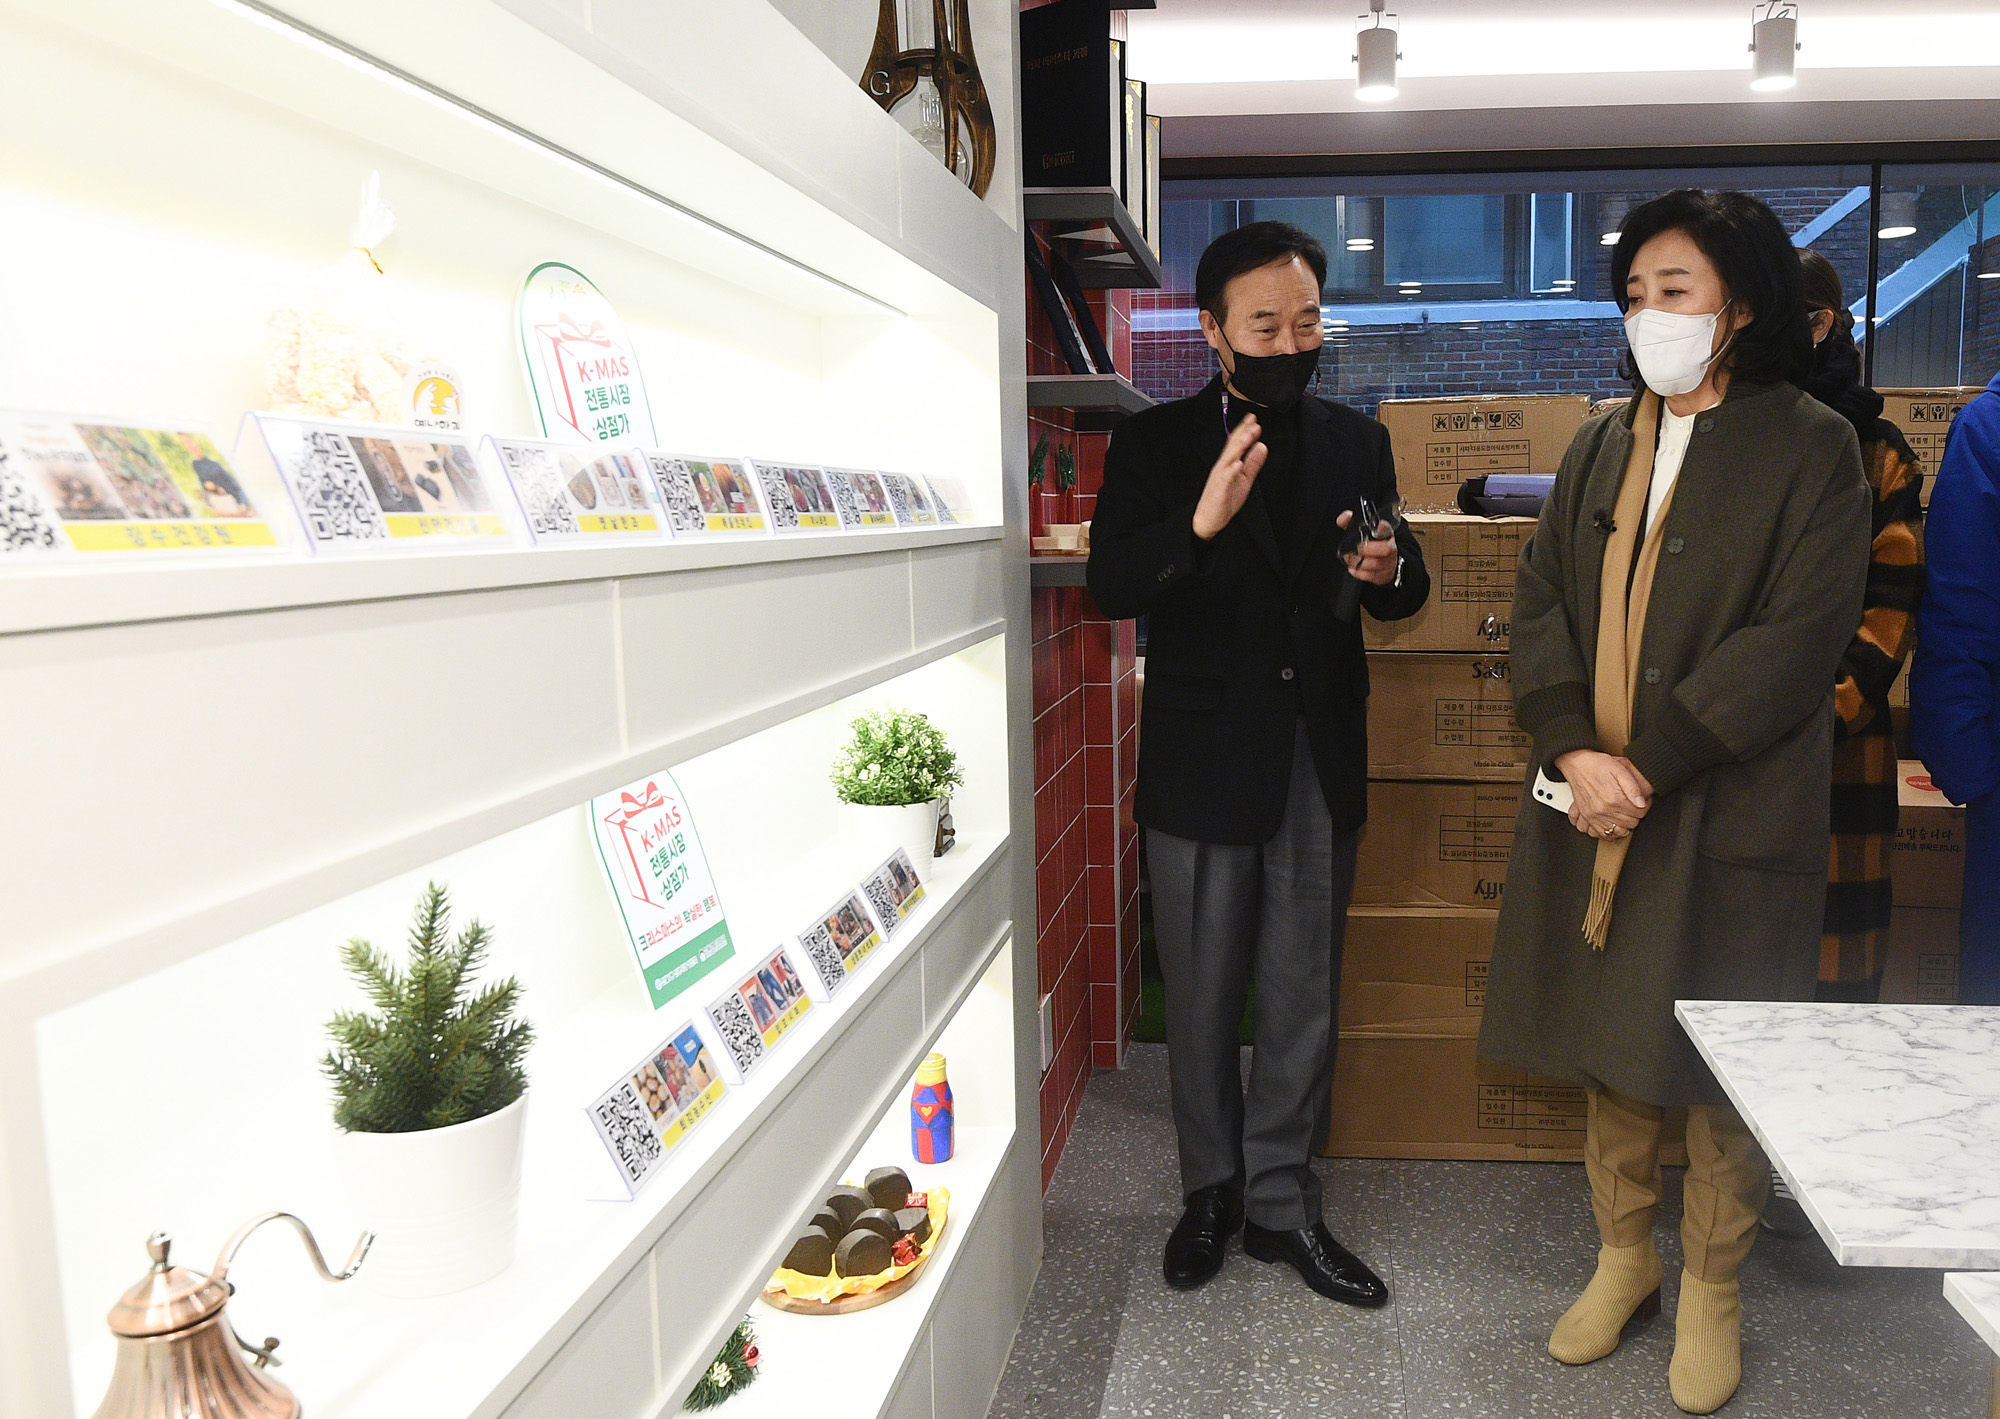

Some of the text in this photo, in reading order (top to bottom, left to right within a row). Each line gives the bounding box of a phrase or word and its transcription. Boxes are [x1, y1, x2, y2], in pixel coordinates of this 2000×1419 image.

[869, 70, 891, 96] G
[576, 355, 630, 384] K-MAS
[584, 383, 631, 412] 전통시장
[1473, 760, 1490, 768] Made
[1490, 760, 1497, 768] in
[640, 804, 682, 854] K-MAS
[1895, 826, 1953, 841] 고맙습니다
[649, 831, 687, 879] 전통시장
[638, 915, 684, 952] 크리스마스의
[682, 901, 704, 925] 확실한
